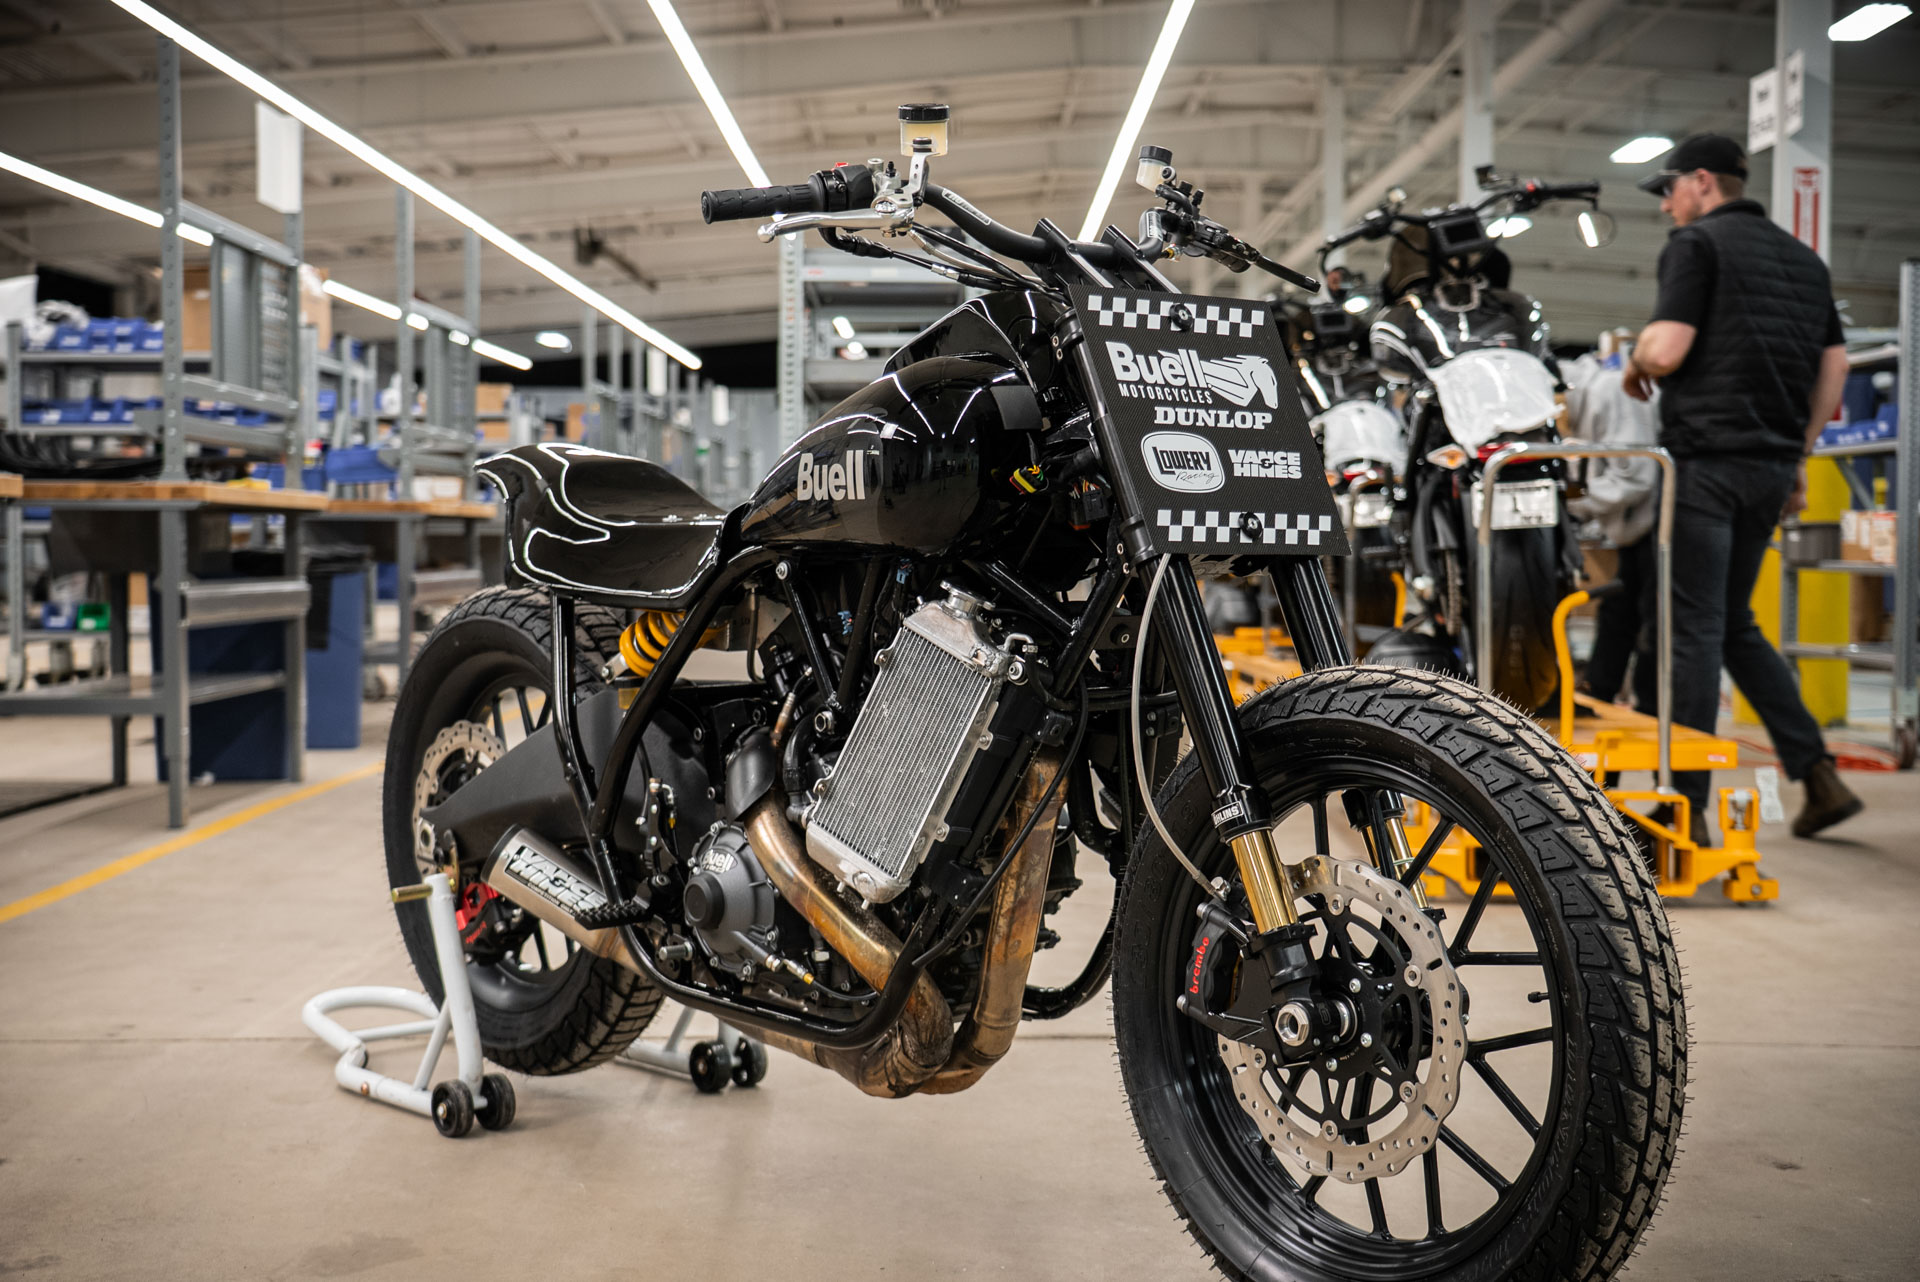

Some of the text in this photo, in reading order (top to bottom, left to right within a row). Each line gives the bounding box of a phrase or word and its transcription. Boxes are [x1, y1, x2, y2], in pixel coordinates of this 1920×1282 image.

[1106, 341, 1208, 388] Buell
[1118, 383, 1213, 405] MOTORCYCLES
[1154, 406, 1272, 429] DUNLOP
[1152, 446, 1212, 476] LOWERY
[1227, 449, 1301, 466] VANCE
[797, 450, 866, 501] Buell
[1175, 471, 1219, 485] Racing
[1233, 463, 1303, 480] HINES
[520, 847, 609, 908] VANCE
[1189, 936, 1210, 994] brembo
